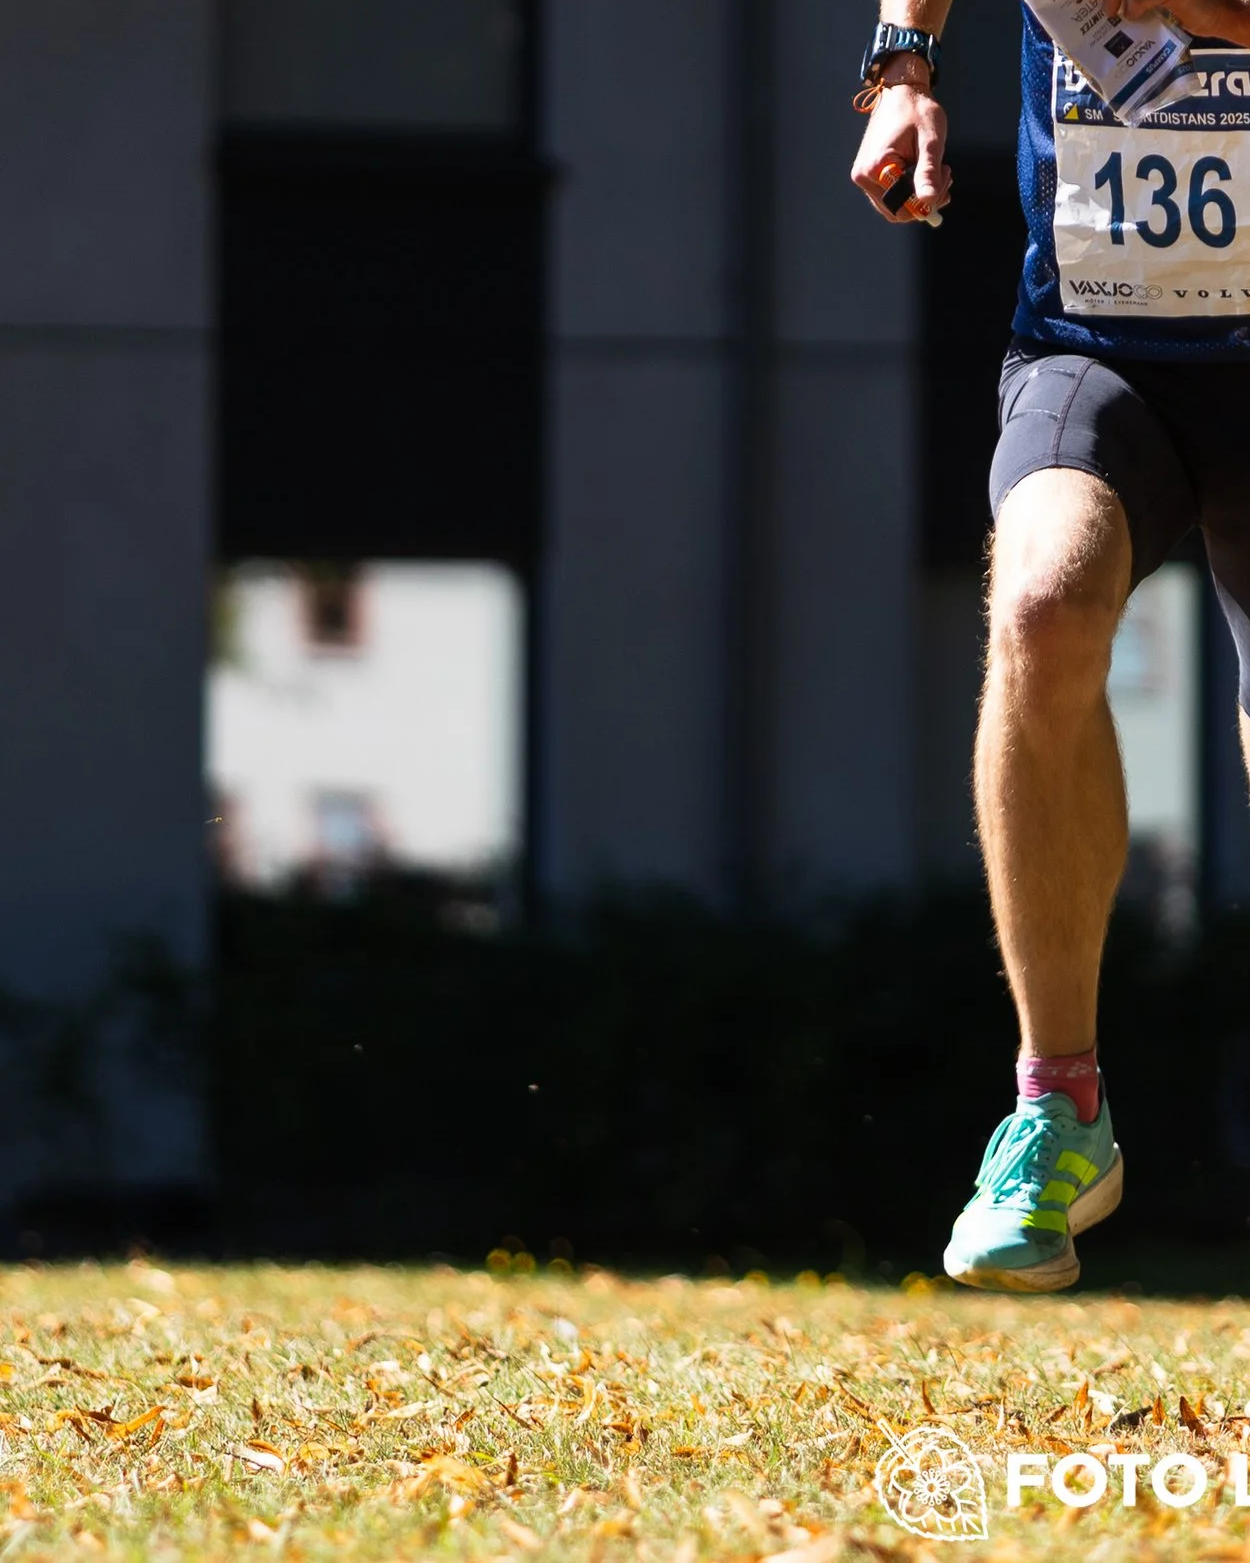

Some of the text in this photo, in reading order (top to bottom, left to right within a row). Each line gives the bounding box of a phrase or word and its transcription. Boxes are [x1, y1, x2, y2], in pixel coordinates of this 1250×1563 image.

[1145, 46, 1171, 74] CAMPUS
[1084, 108, 1104, 121] SM
[1220, 111, 1250, 125] 2025
[1095, 151, 1237, 249] 136
